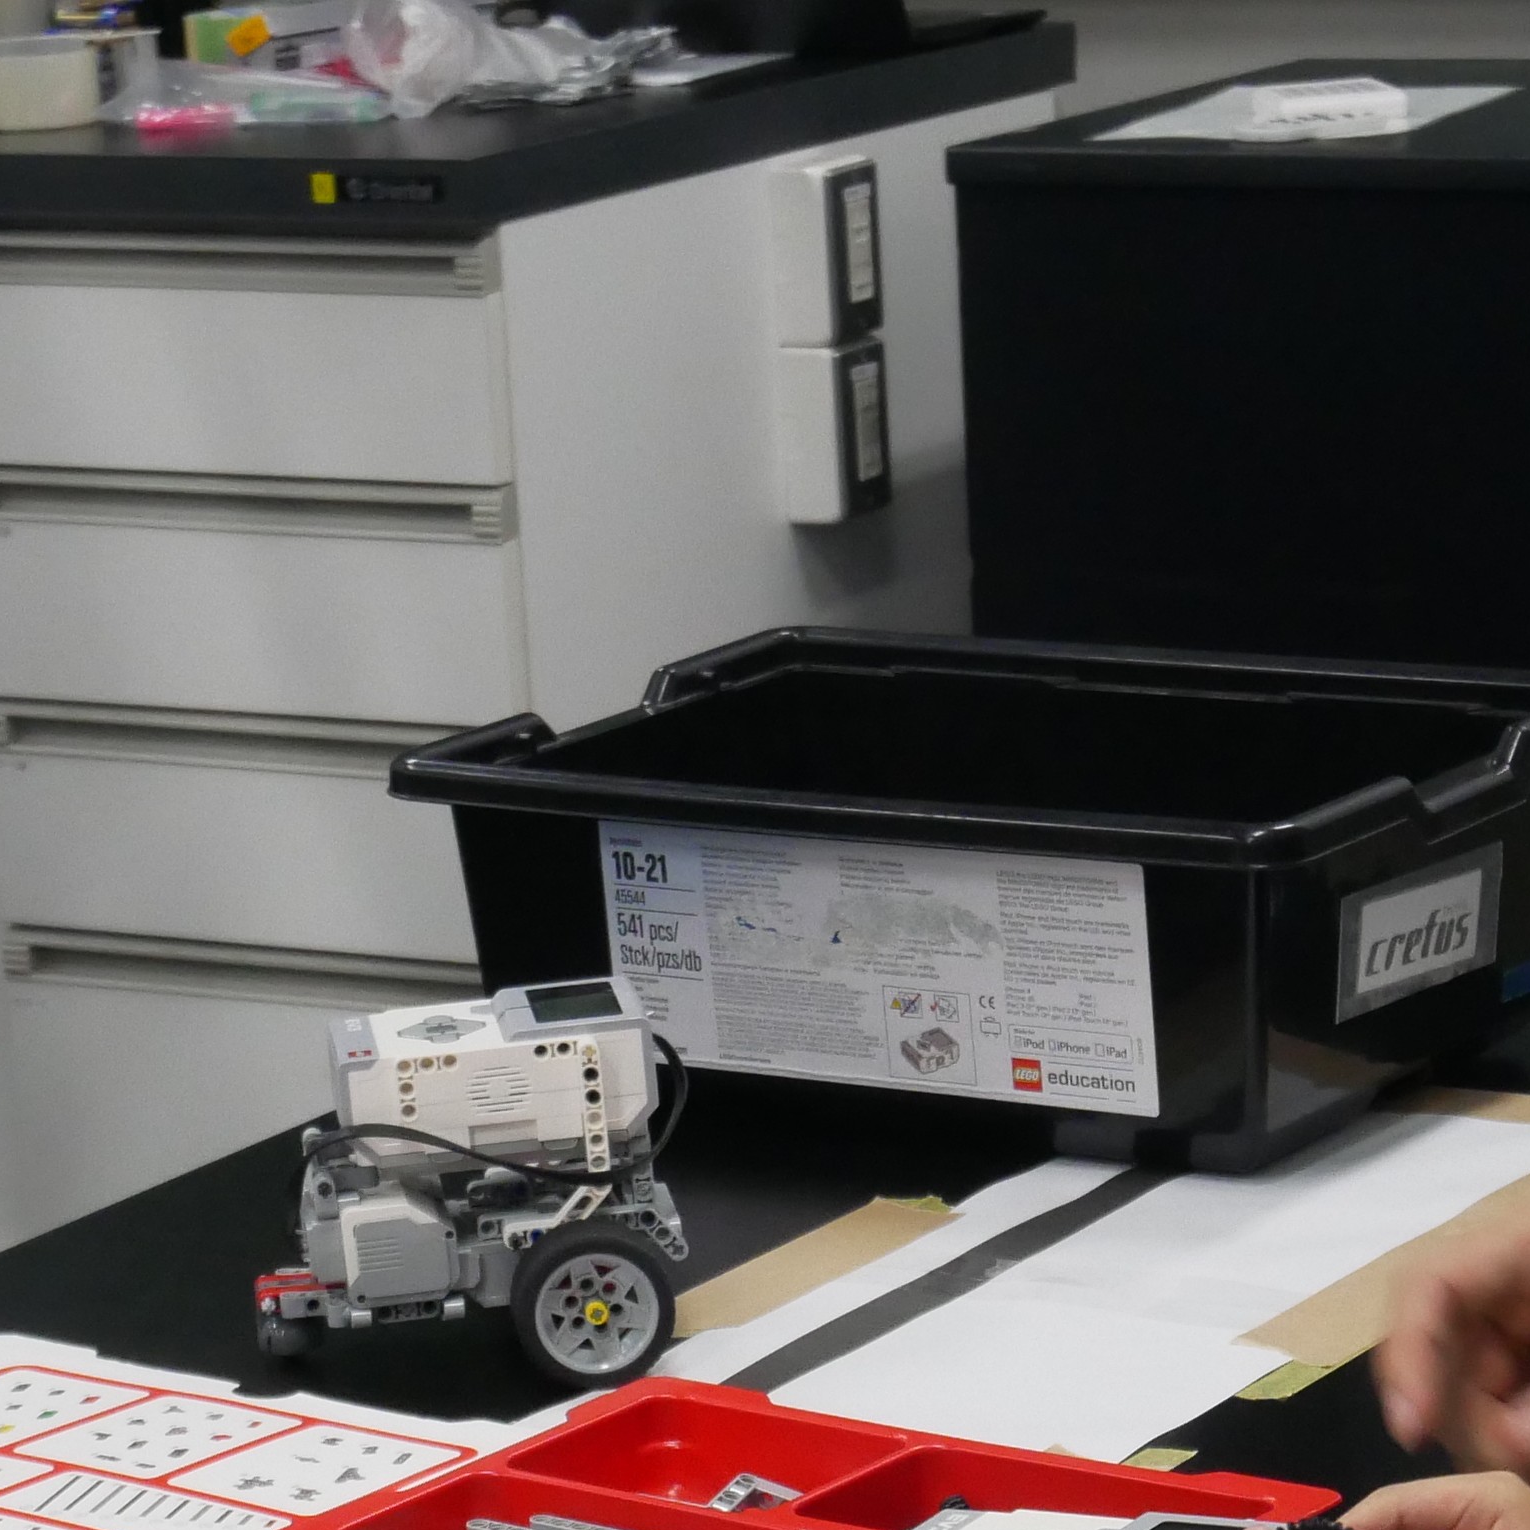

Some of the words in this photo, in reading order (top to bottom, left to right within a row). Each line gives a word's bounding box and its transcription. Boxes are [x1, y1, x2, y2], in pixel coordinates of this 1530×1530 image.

[612, 851, 668, 883] 10-21
[614, 889, 646, 906] 45544
[617, 913, 644, 938] 541
[649, 921, 679, 945] pcs/
[1364, 908, 1472, 977] crefus
[620, 945, 702, 973] Stck/pzs/db
[1023, 1037, 1045, 1050] iPod
[1057, 1040, 1091, 1054] iPhone
[1106, 1046, 1127, 1059] iPad
[1048, 1070, 1136, 1093] education
